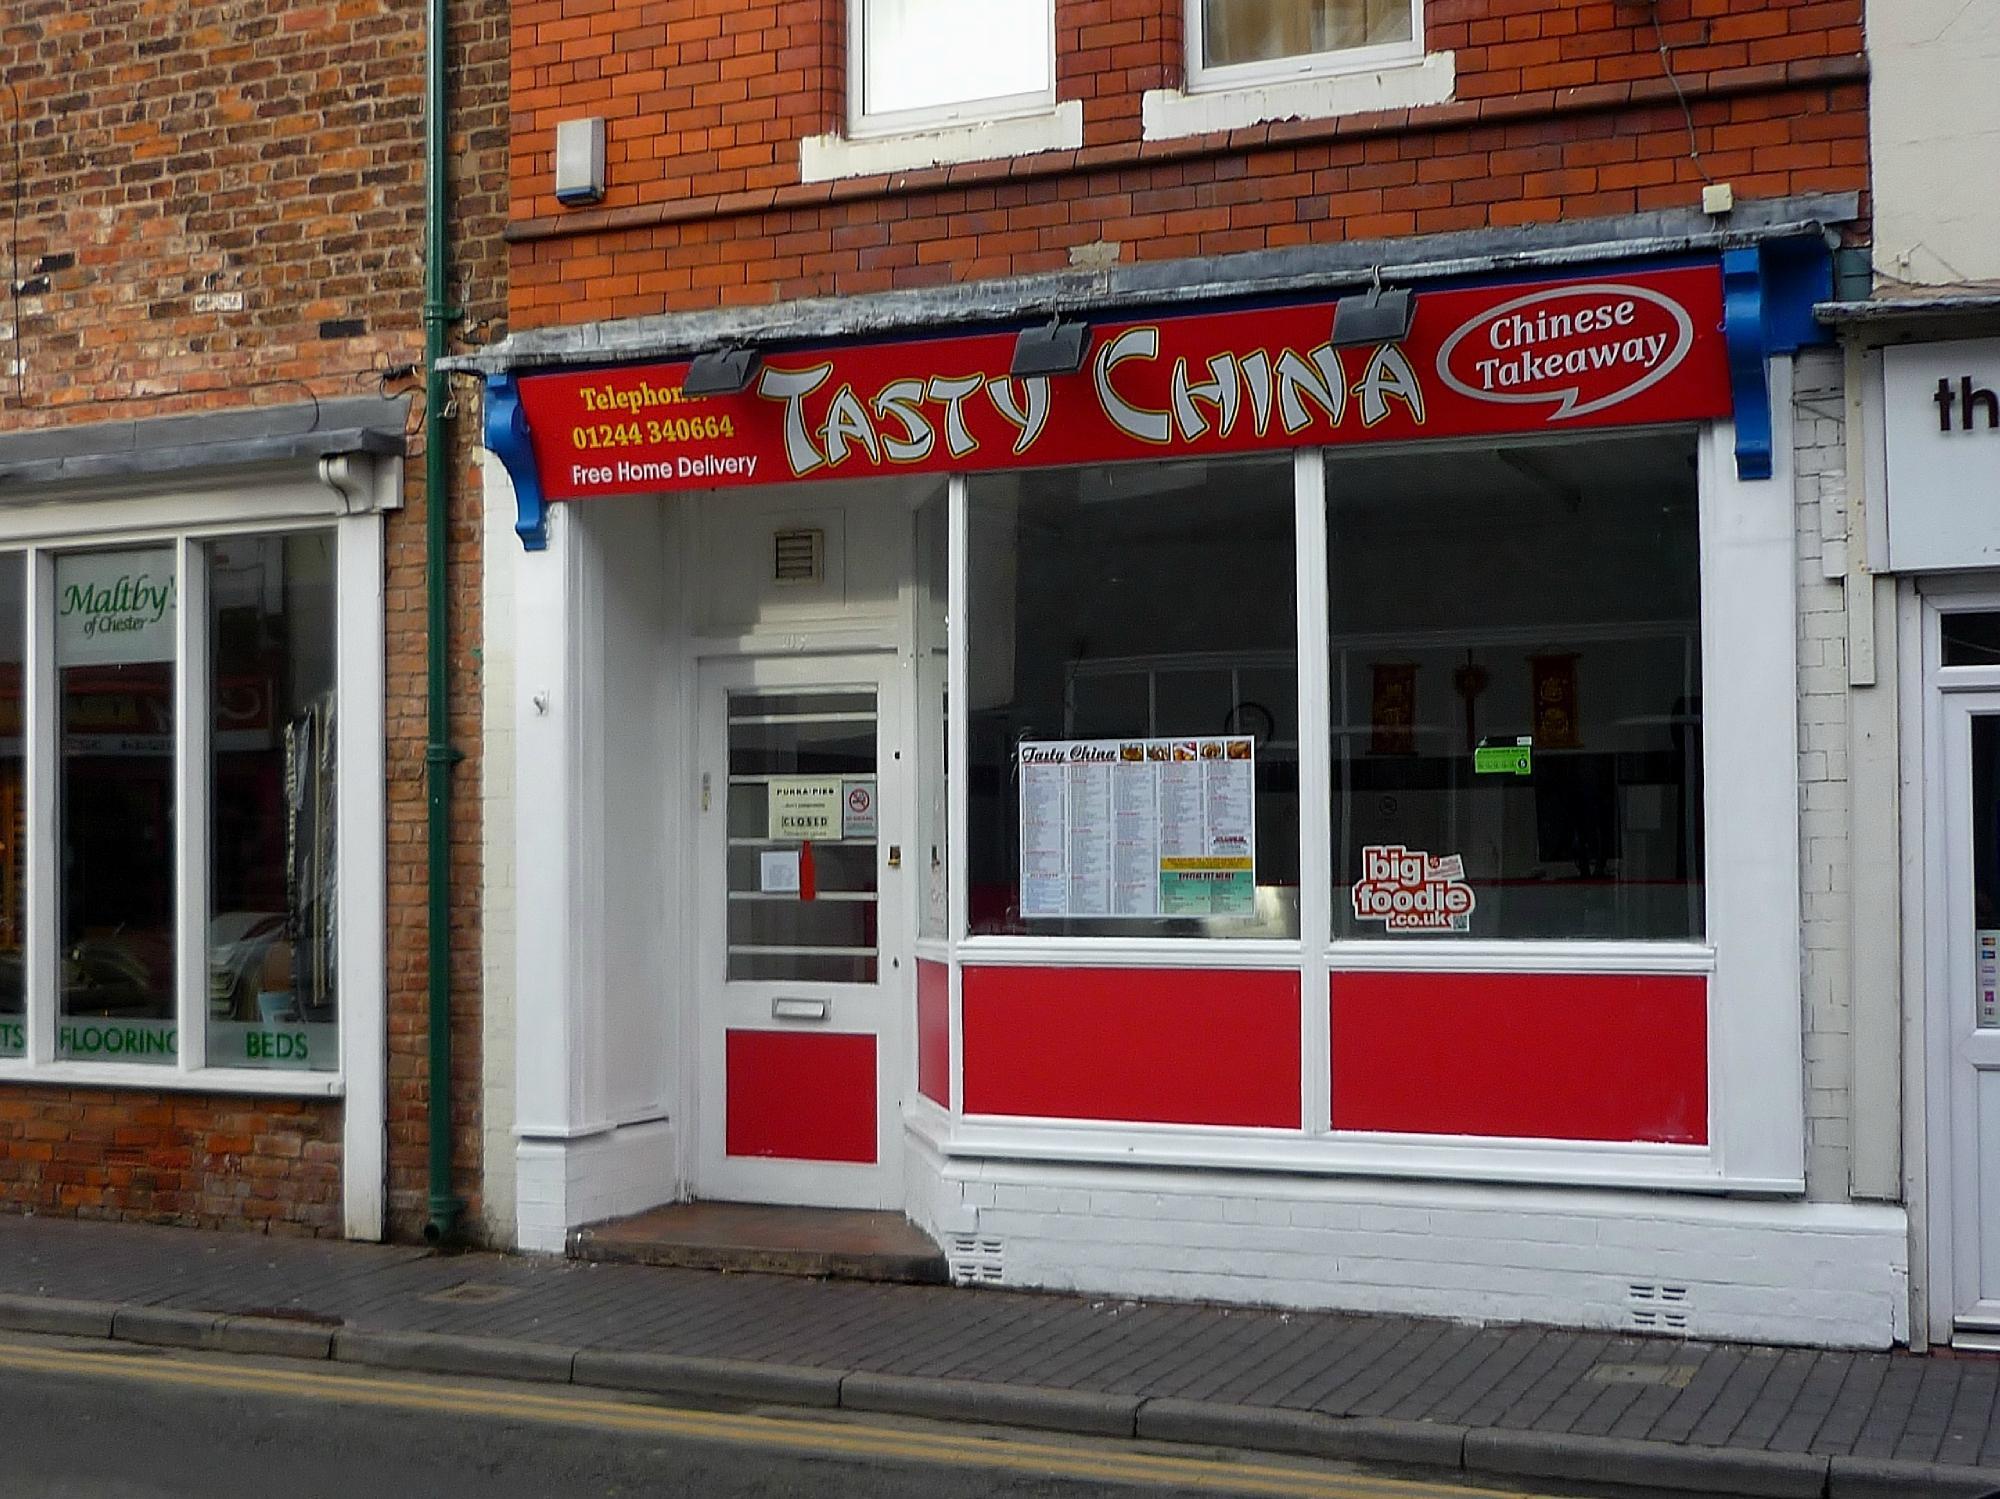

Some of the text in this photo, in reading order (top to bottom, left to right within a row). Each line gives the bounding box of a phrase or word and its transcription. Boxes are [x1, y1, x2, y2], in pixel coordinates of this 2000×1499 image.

[1489, 301, 1636, 350] Chinese
[1475, 332, 1669, 392] Takeaway
[758, 326, 1426, 475] TASTY CHINA
[572, 415, 734, 450] 01244 340664
[572, 454, 758, 485] Free Home Delivery
[60, 574, 177, 622] Maltby'
[84, 615, 147, 639] of Chester
[1070, 744, 1117, 761] China
[1369, 852, 1421, 886] big
[1358, 883, 1468, 912] foodie
[1390, 910, 1449, 927] .co.uk
[246, 1031, 309, 1059] BEDS
